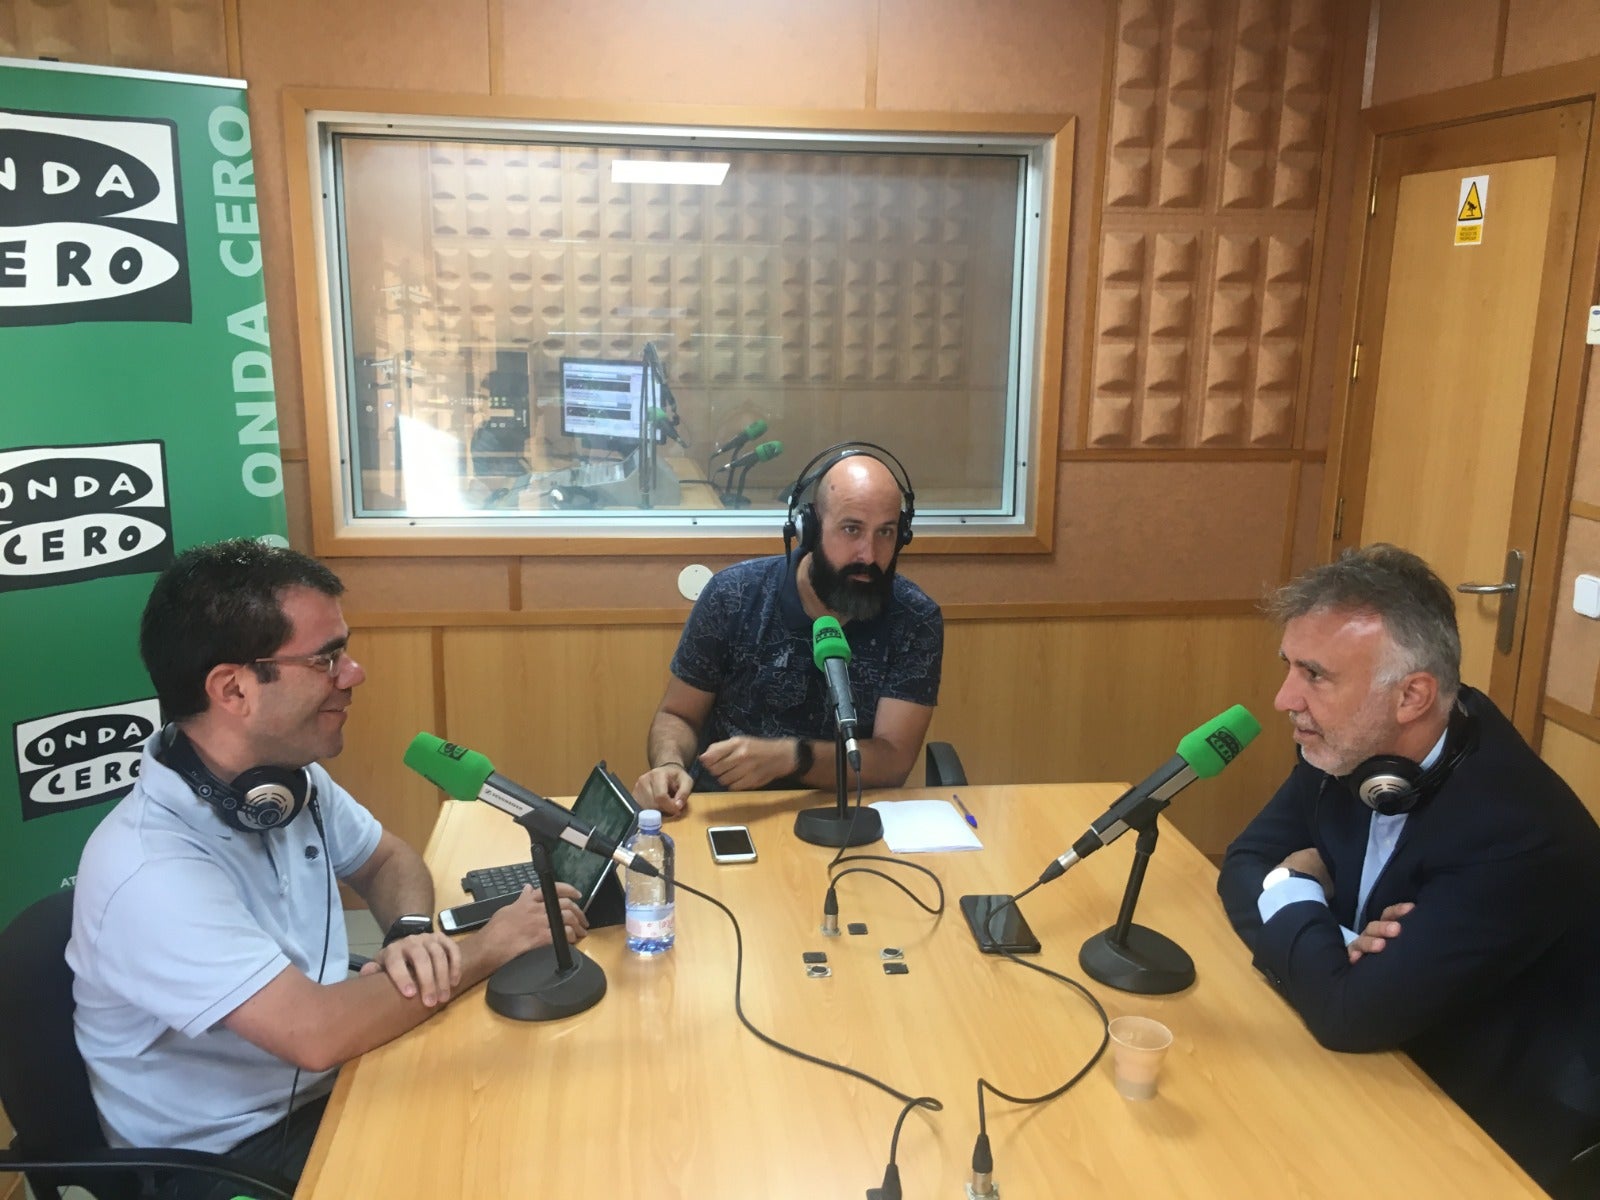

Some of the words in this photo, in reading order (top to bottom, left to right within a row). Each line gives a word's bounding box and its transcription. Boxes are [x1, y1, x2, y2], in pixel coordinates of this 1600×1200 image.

[208, 105, 263, 277] CERO
[227, 301, 283, 497] ONDA
[0, 473, 136, 509] ONDA
[4, 525, 141, 565] CERO
[37, 722, 142, 757] ONDA
[48, 759, 142, 795] CERO
[60, 875, 77, 889] AT
